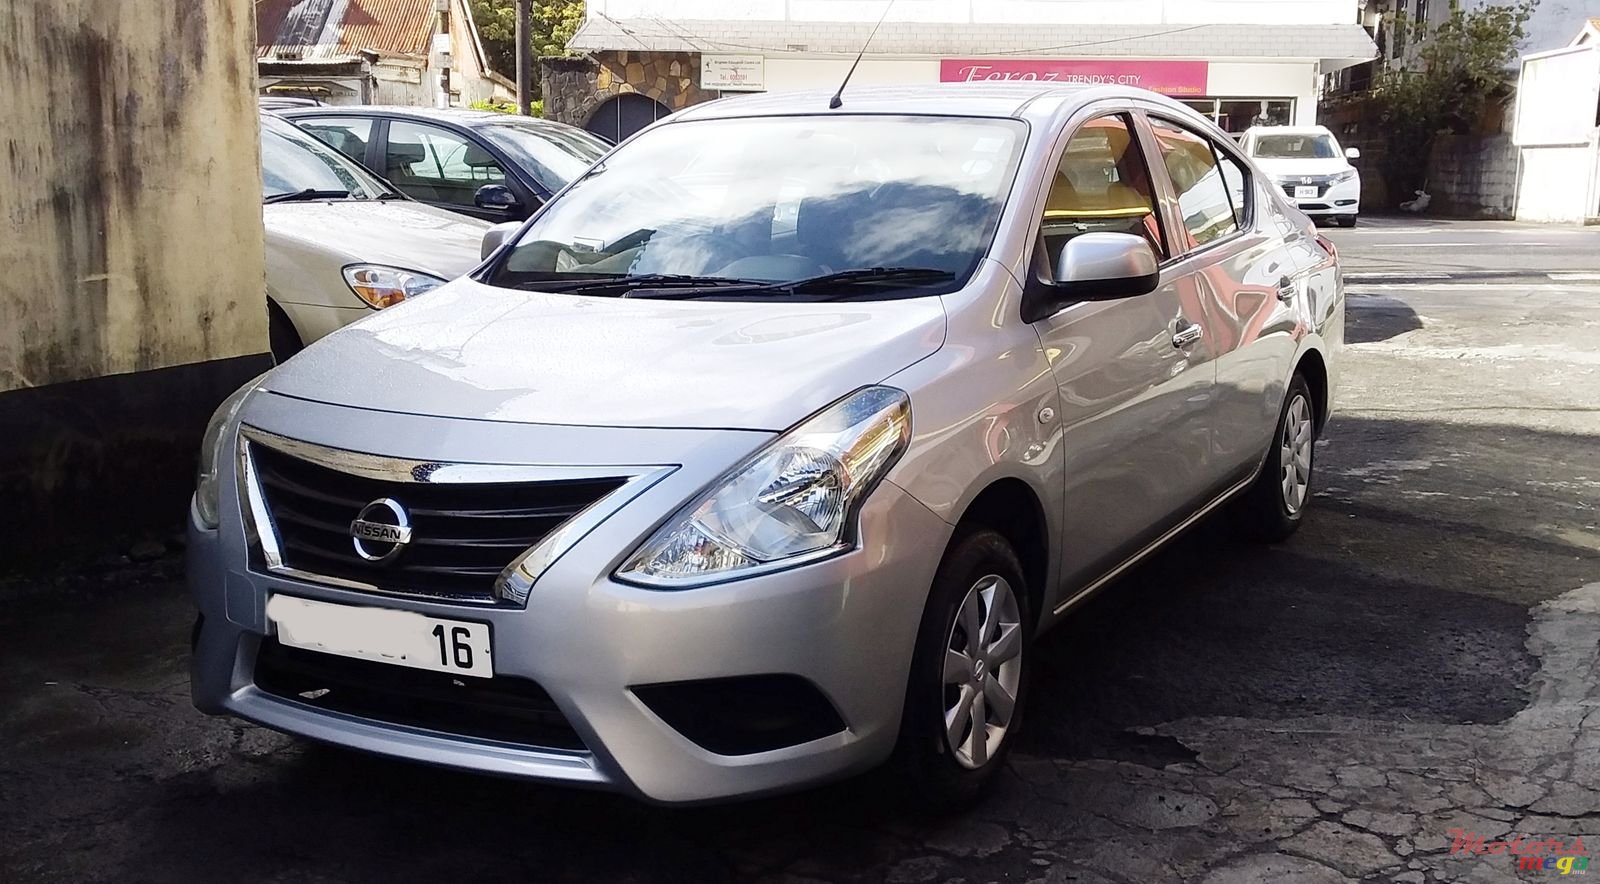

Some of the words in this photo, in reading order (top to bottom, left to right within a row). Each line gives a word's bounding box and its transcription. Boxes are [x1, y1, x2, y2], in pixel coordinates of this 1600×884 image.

[1067, 74, 1115, 84] TRENDY'S
[1117, 75, 1141, 84] CITY
[353, 522, 401, 540] NISSAN
[432, 624, 473, 668] 16
